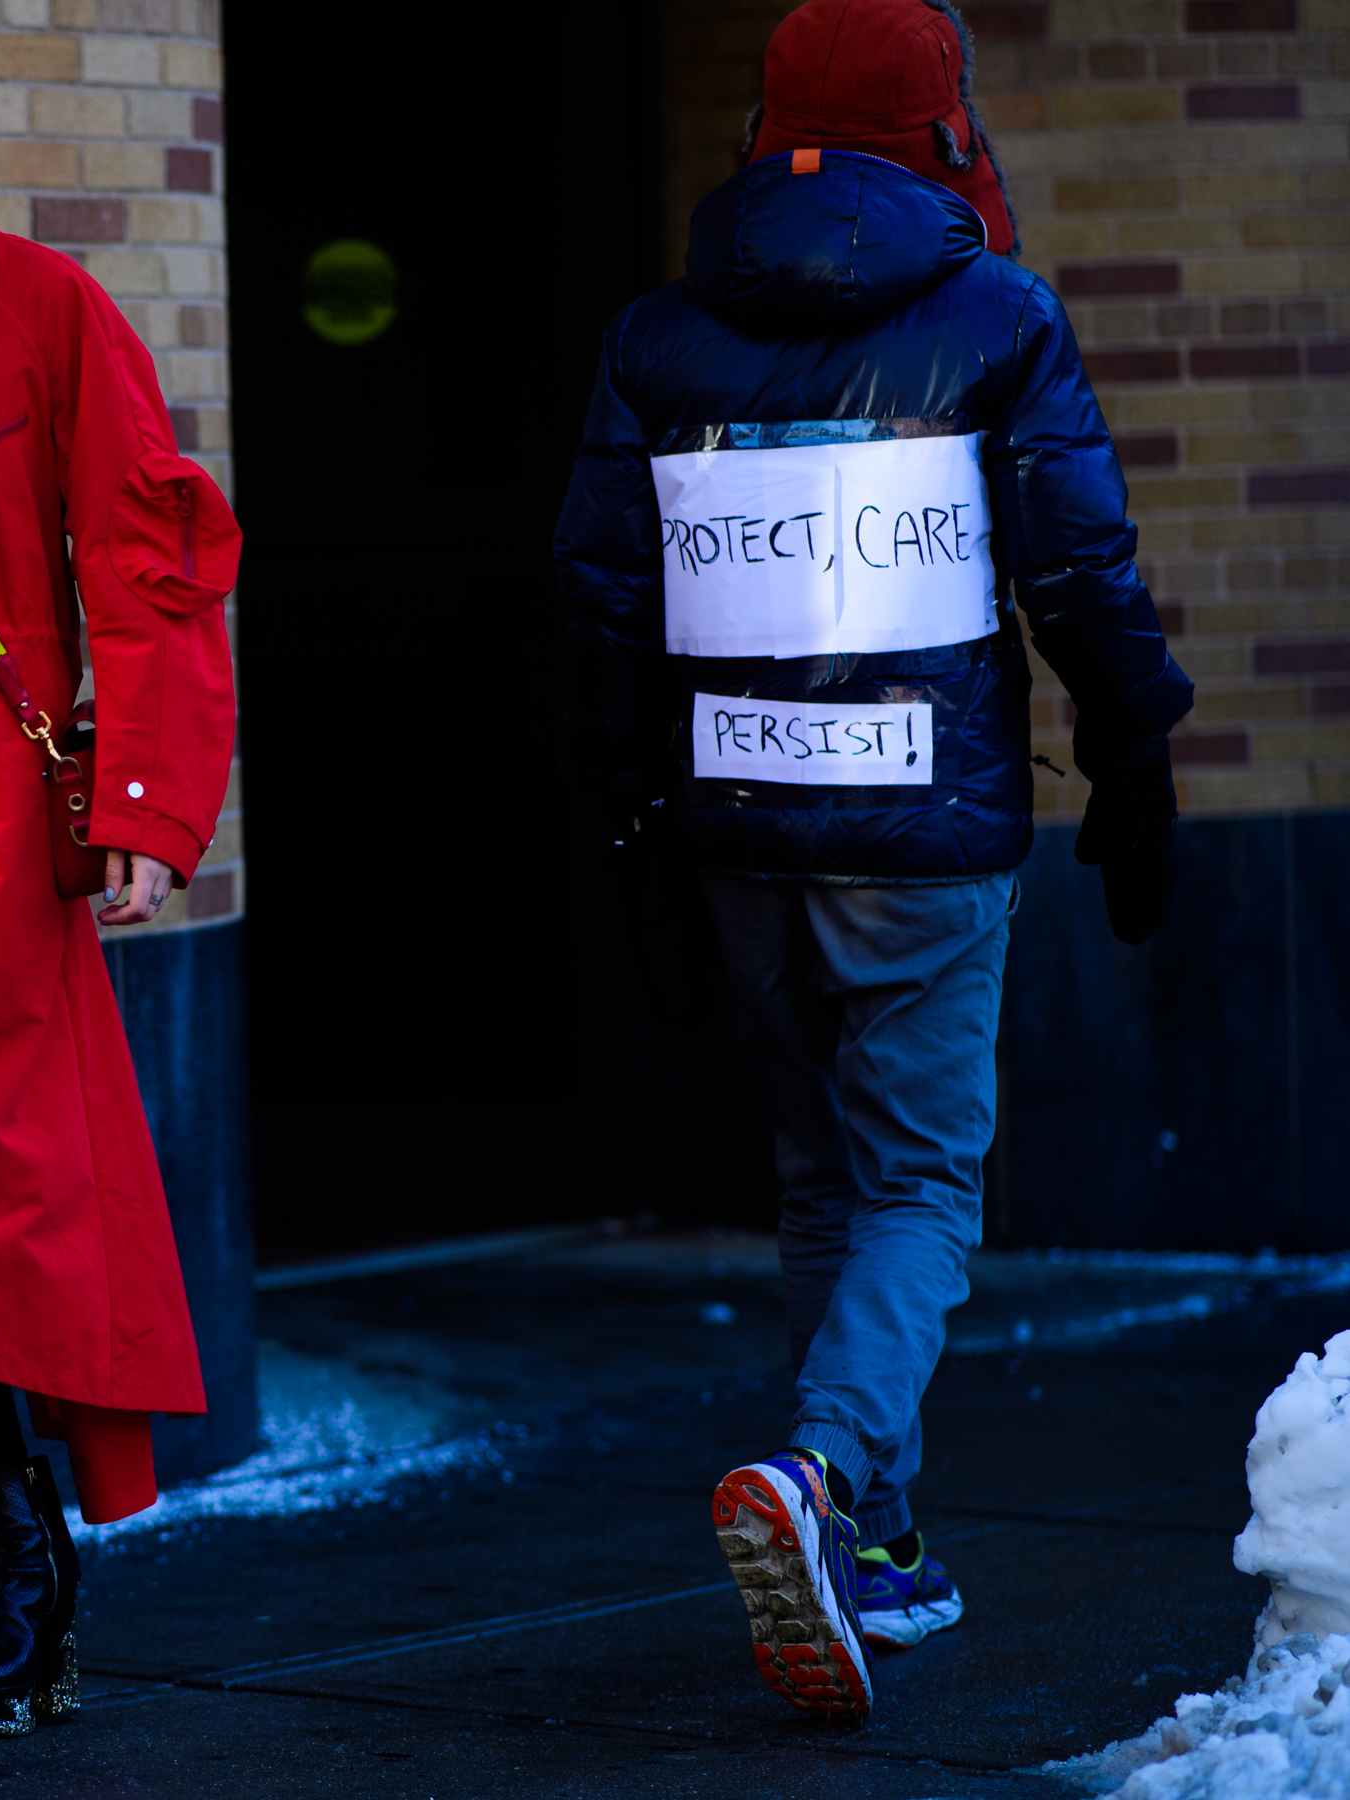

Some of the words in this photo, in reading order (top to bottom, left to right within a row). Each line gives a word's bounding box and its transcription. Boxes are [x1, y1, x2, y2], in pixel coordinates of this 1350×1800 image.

[662, 511, 834, 577] PROTECT,
[854, 503, 970, 569] CARE
[714, 709, 918, 768] PERSIST!
